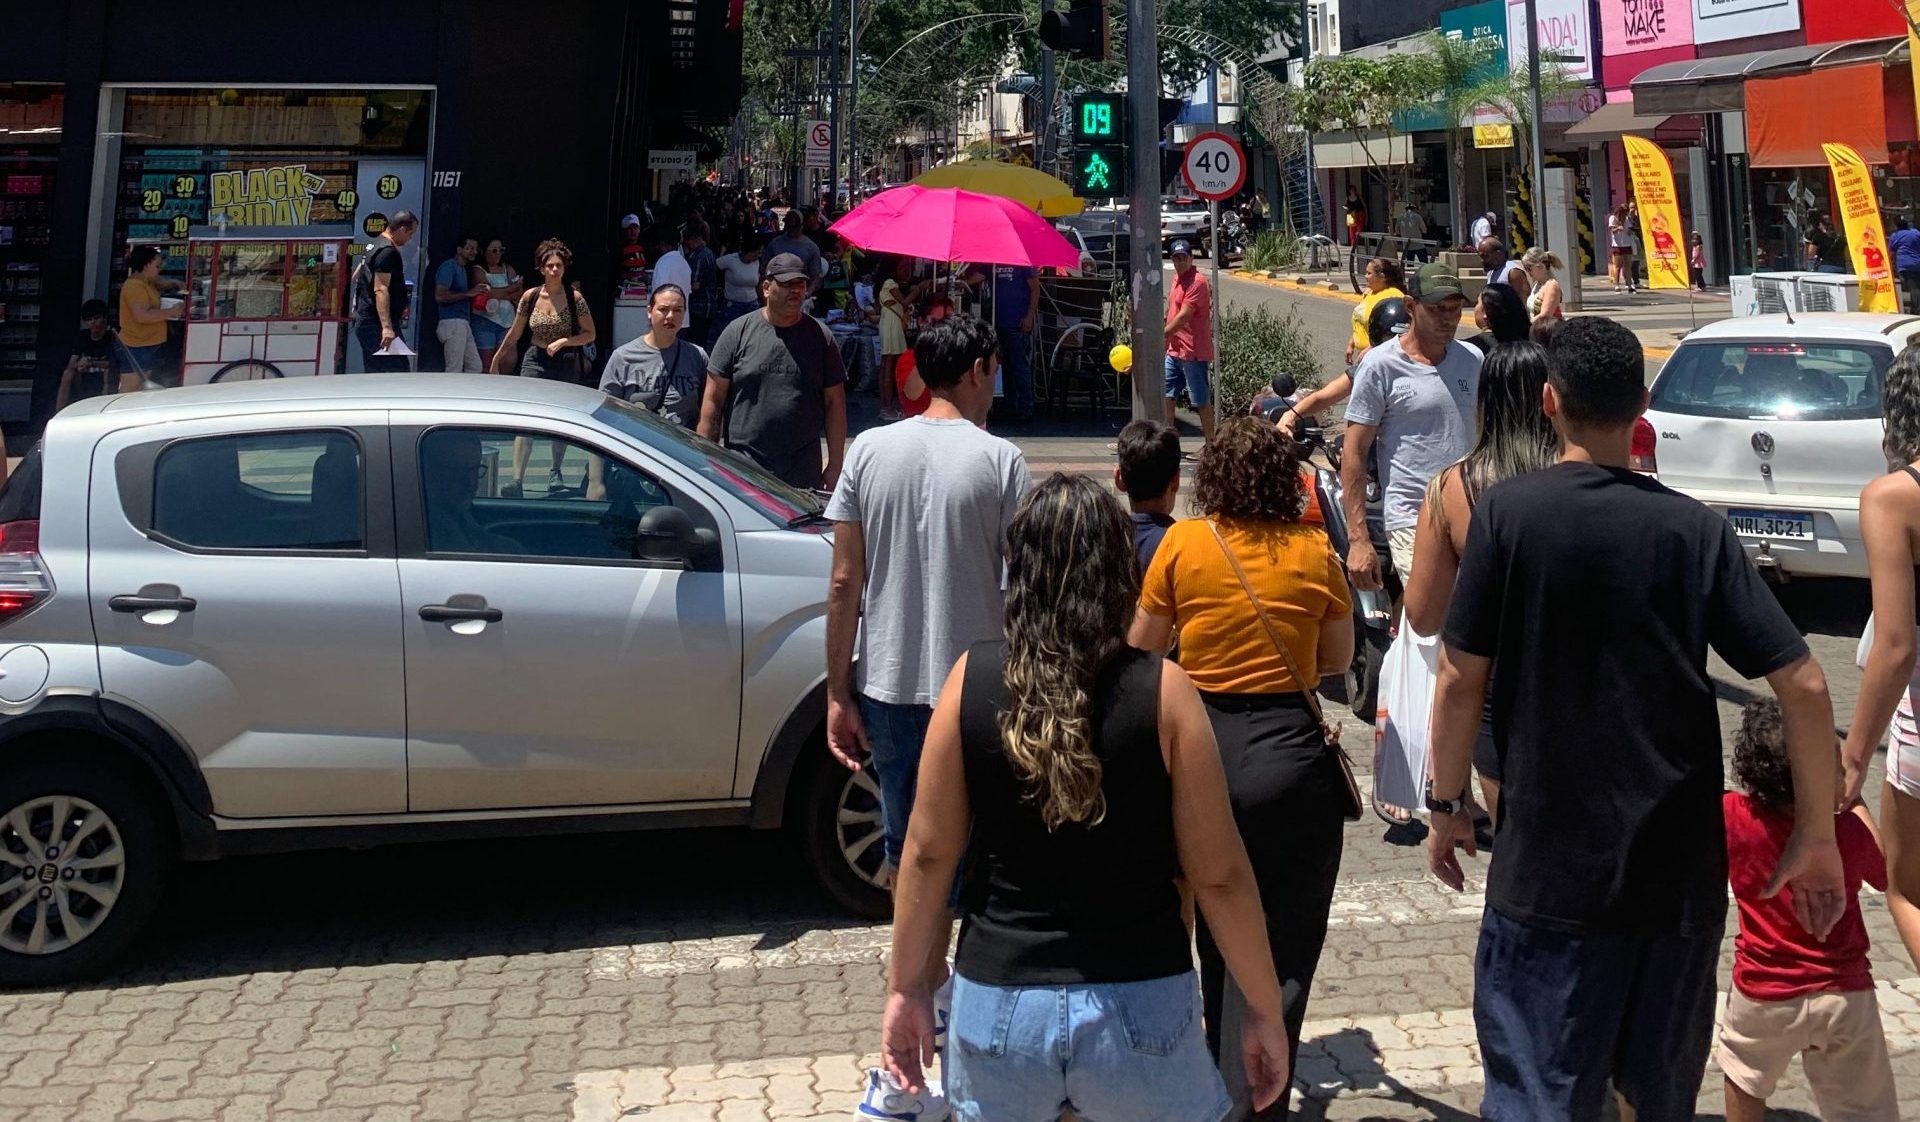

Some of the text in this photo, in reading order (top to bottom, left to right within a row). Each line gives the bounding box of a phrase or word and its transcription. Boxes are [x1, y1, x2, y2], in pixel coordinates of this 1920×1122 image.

[1536, 13, 1578, 48] INDA!
[1624, 9, 1666, 40] MAKE
[1083, 104, 1111, 134] 09
[650, 156, 682, 164] STUDIO
[1195, 151, 1231, 173] 40
[177, 177, 194, 193] 30
[212, 167, 306, 207] BLACK
[380, 177, 398, 193] 50
[433, 171, 461, 188] 1161
[143, 190, 161, 206] 20
[338, 191, 356, 206] 40
[209, 197, 311, 226] FRIDAY
[173, 216, 188, 233] 10
[1662, 431, 1681, 441] GOL
[1734, 516, 1806, 538] NRL3C21
